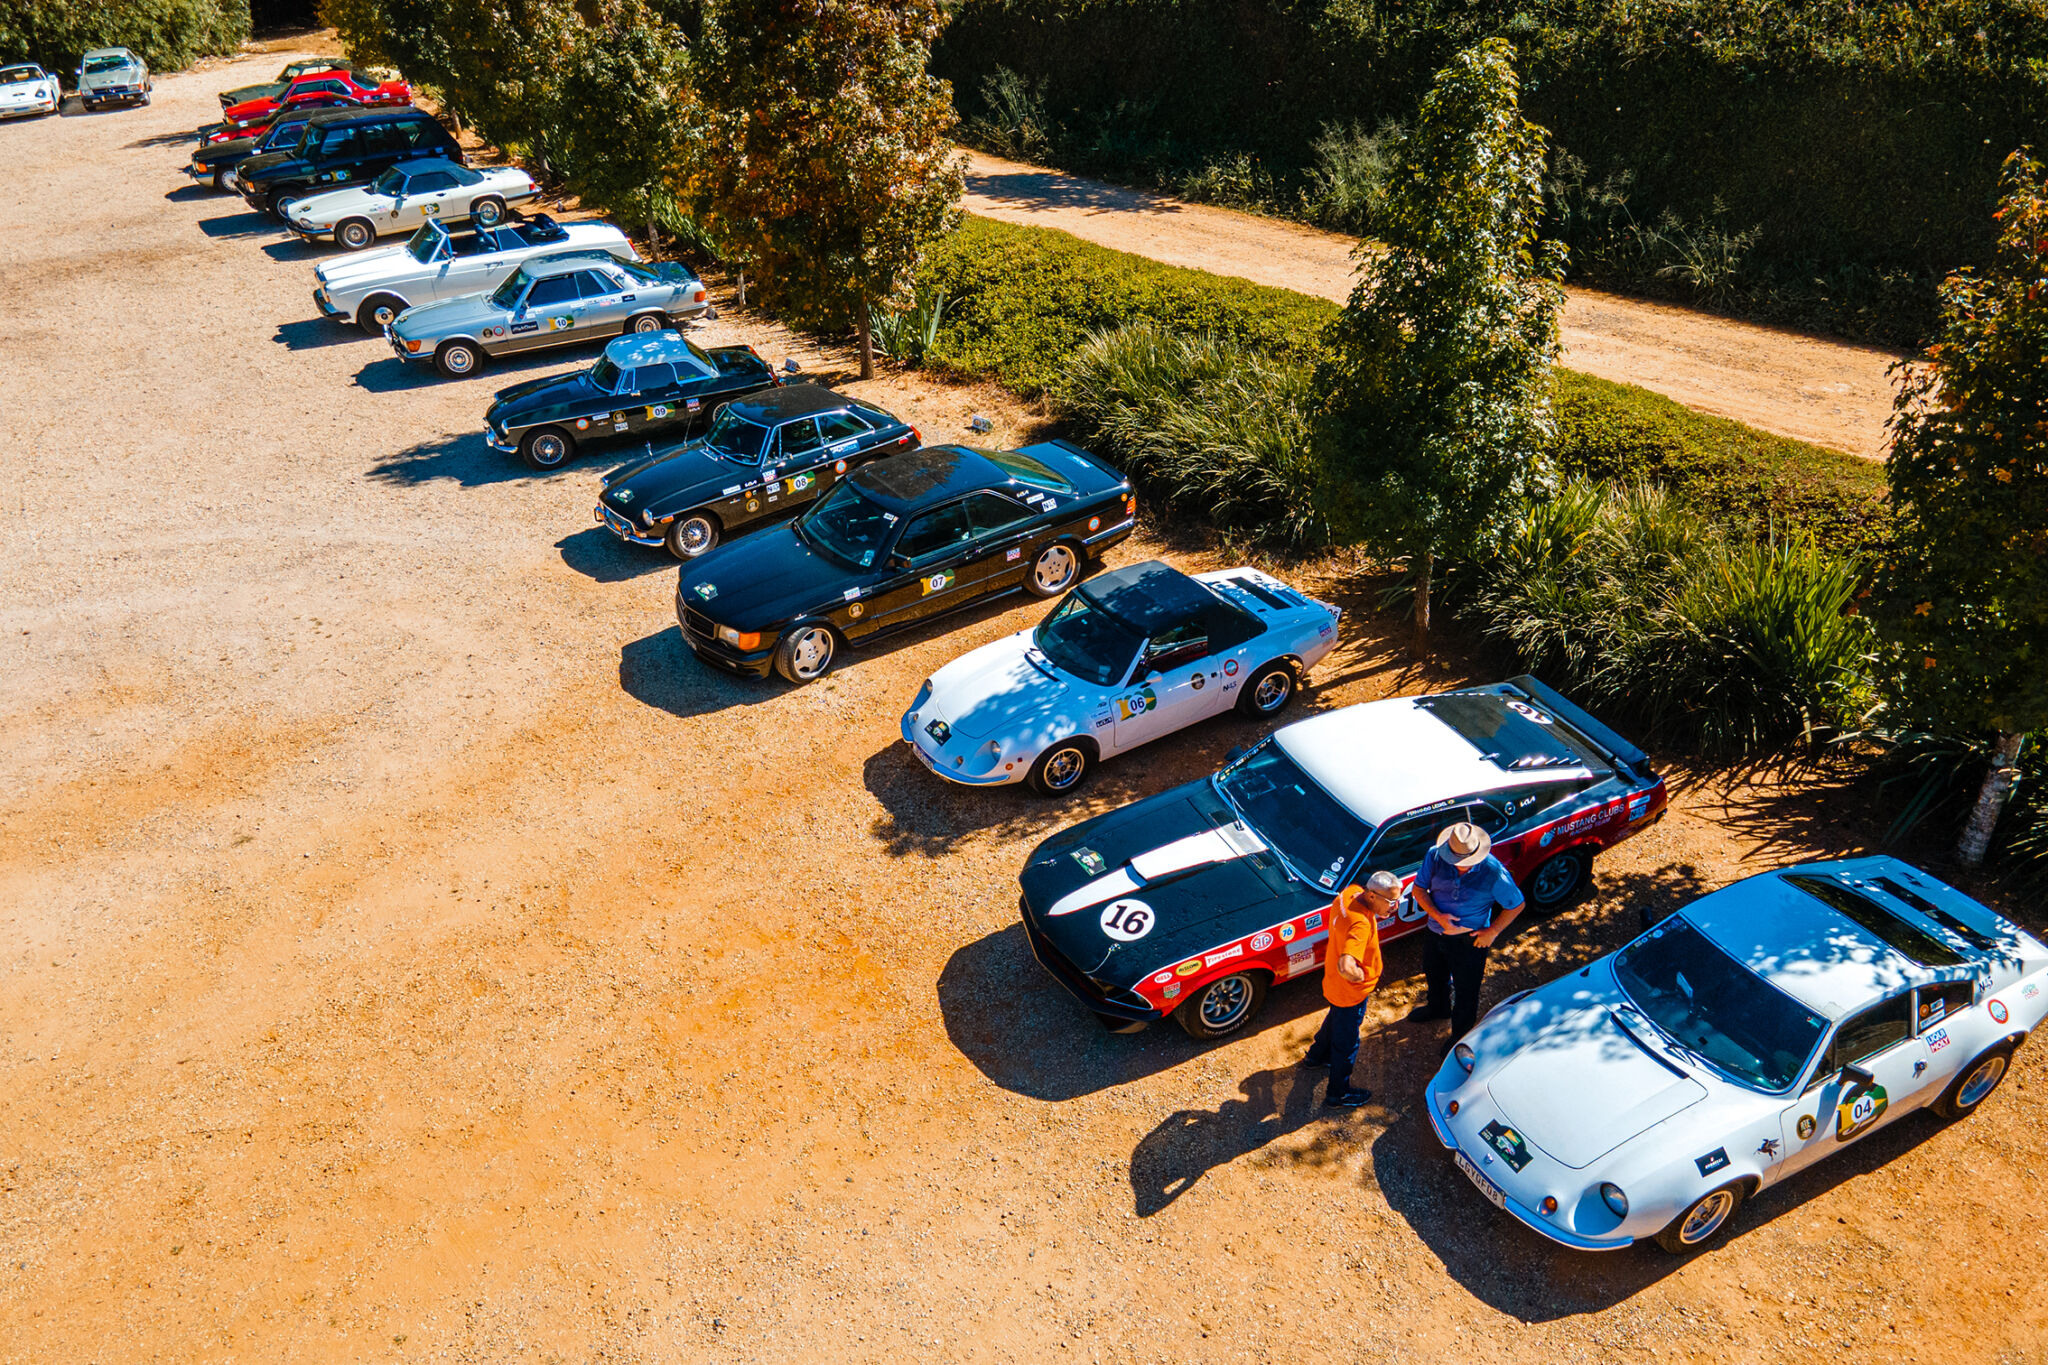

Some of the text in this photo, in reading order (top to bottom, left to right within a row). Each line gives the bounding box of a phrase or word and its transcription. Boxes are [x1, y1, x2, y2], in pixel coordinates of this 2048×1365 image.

[557, 317, 567, 327] 10
[654, 407, 666, 416] 09
[795, 477, 807, 488] 08
[931, 576, 945, 588] 07
[1130, 697, 1145, 711] 06
[1557, 814, 1597, 835] MUSTANG
[1598, 803, 1625, 820] CLUBS
[1104, 904, 1150, 935] 16
[1282, 926, 1294, 938] 76
[1253, 935, 1271, 950] STP
[1207, 948, 1241, 964] Firestone
[1927, 1028, 1947, 1044] LIQUI
[1930, 1038, 1951, 1053] MOLY
[1854, 1100, 1873, 1118] 04
